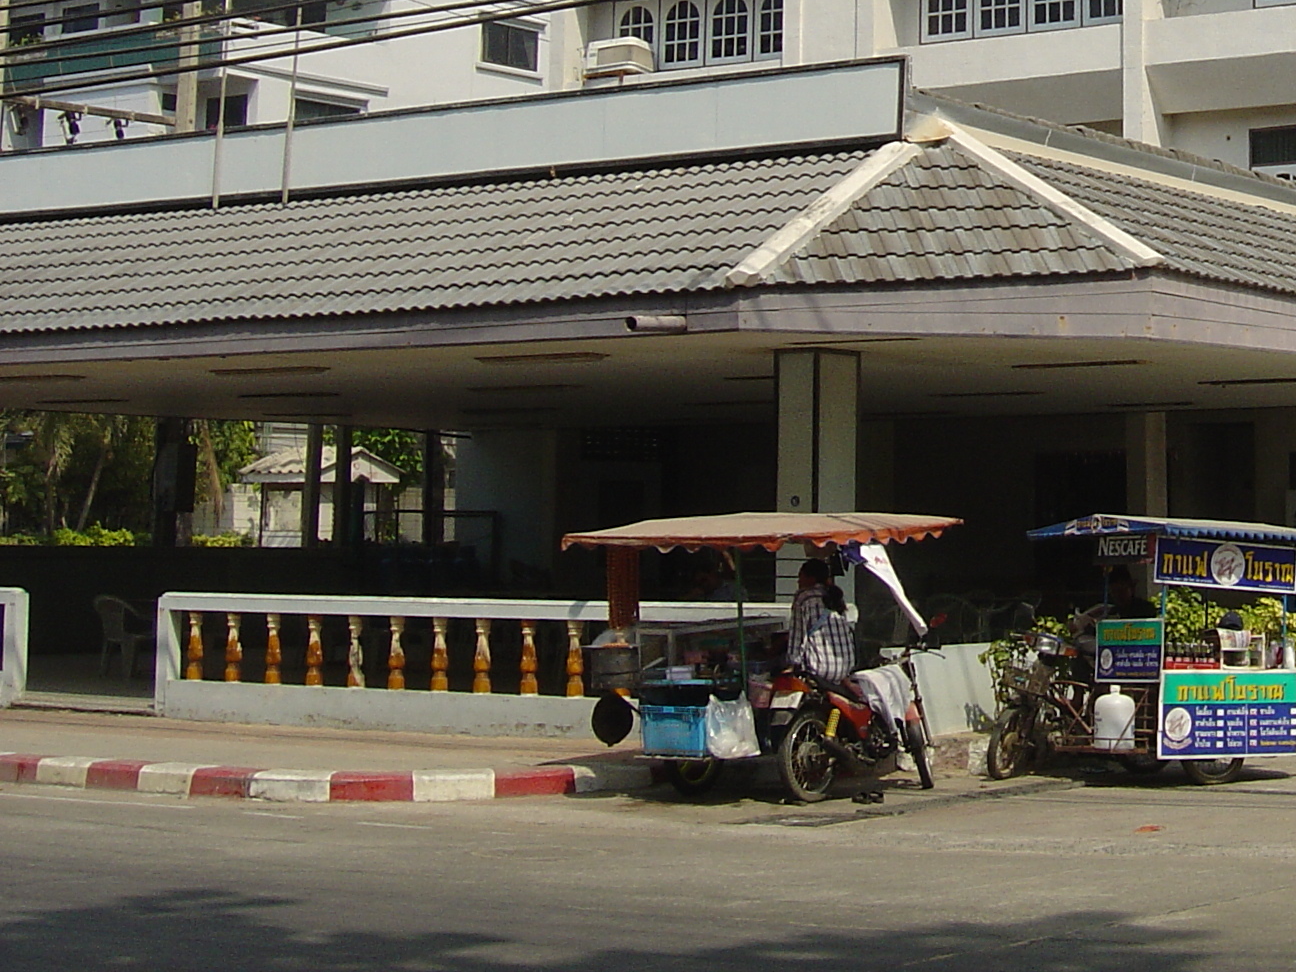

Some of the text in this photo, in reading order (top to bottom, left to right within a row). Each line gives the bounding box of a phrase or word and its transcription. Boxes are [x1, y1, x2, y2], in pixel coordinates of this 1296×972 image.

[1098, 535, 1147, 556] NESCAFÉ
[1162, 550, 1294, 584] กาแฟ โบราณ
[1177, 675, 1284, 702] กาแฟโบราณ
